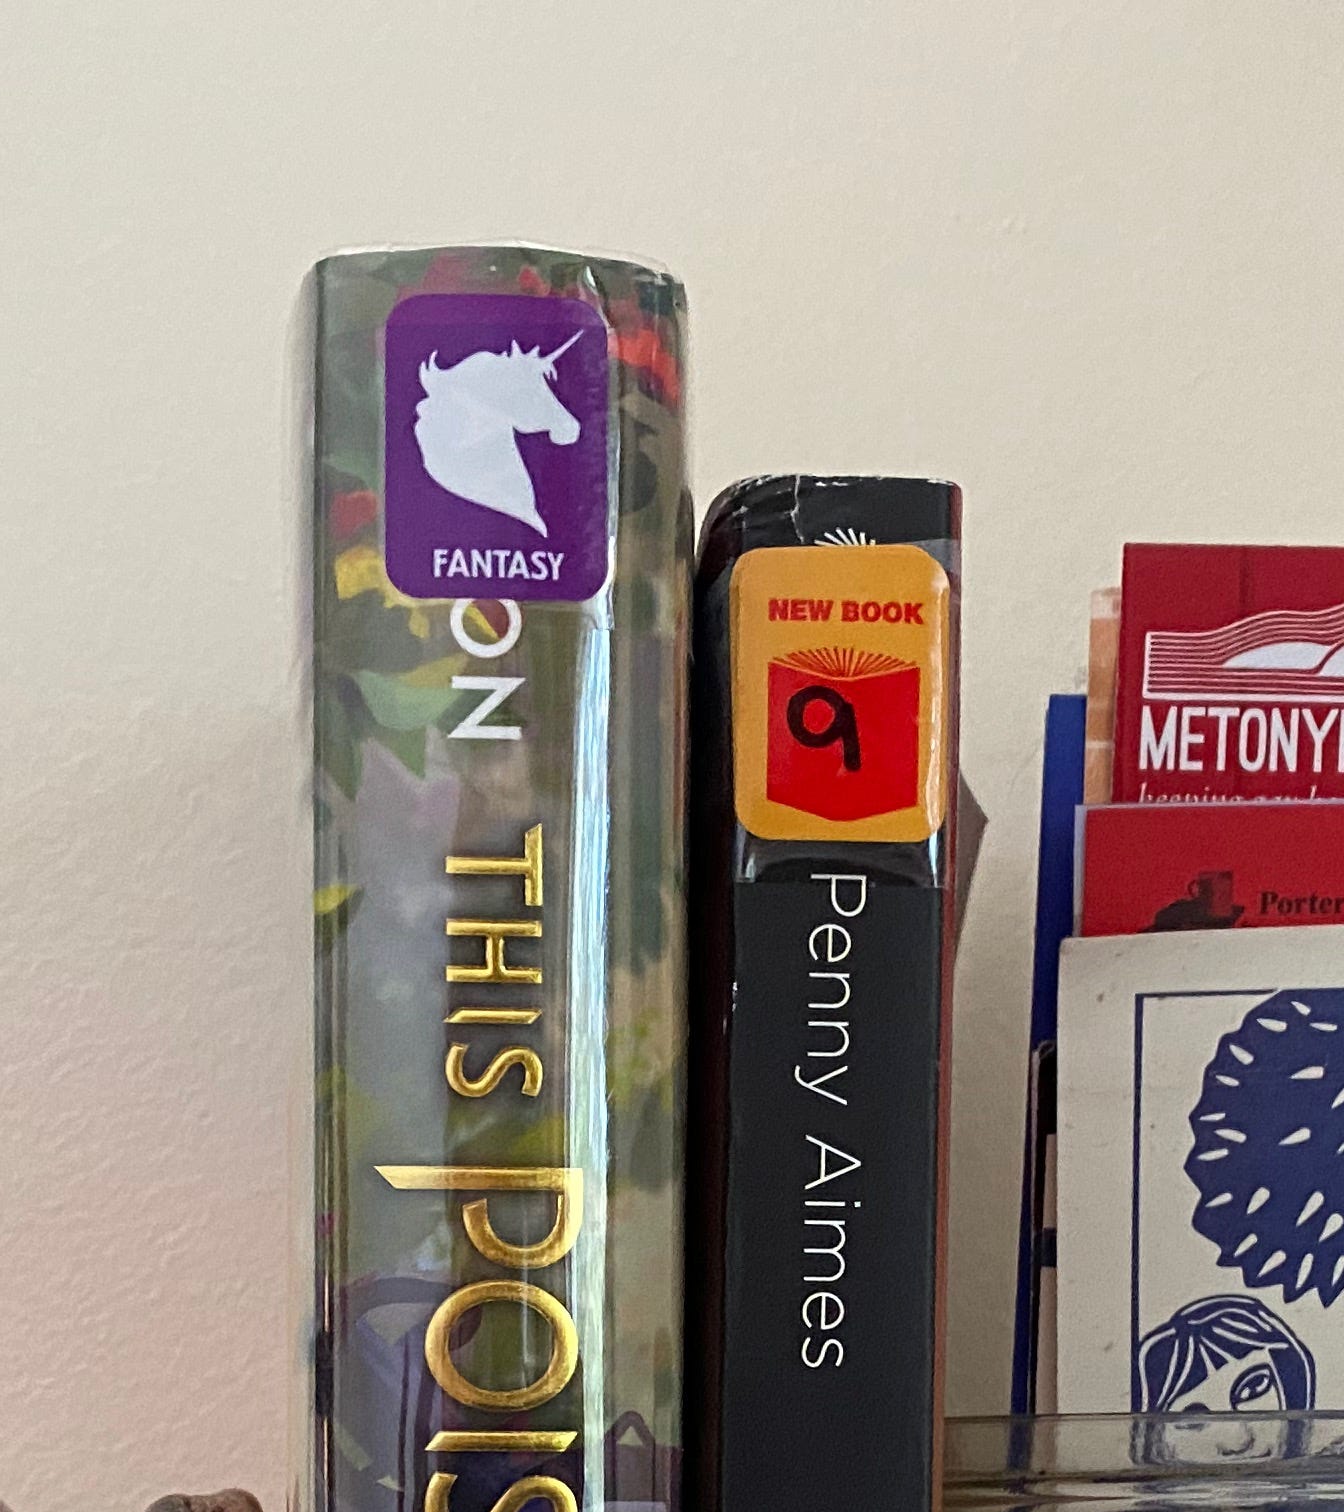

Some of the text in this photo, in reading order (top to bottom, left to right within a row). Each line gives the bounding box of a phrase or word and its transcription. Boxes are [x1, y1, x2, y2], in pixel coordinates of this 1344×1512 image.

[432, 547, 565, 582] FANTASY
[767, 597, 925, 625] NEW BOOK
[786, 684, 862, 773] 9
[443, 822, 544, 1098] THIS
[793, 872, 868, 1370] Penny Aimes
